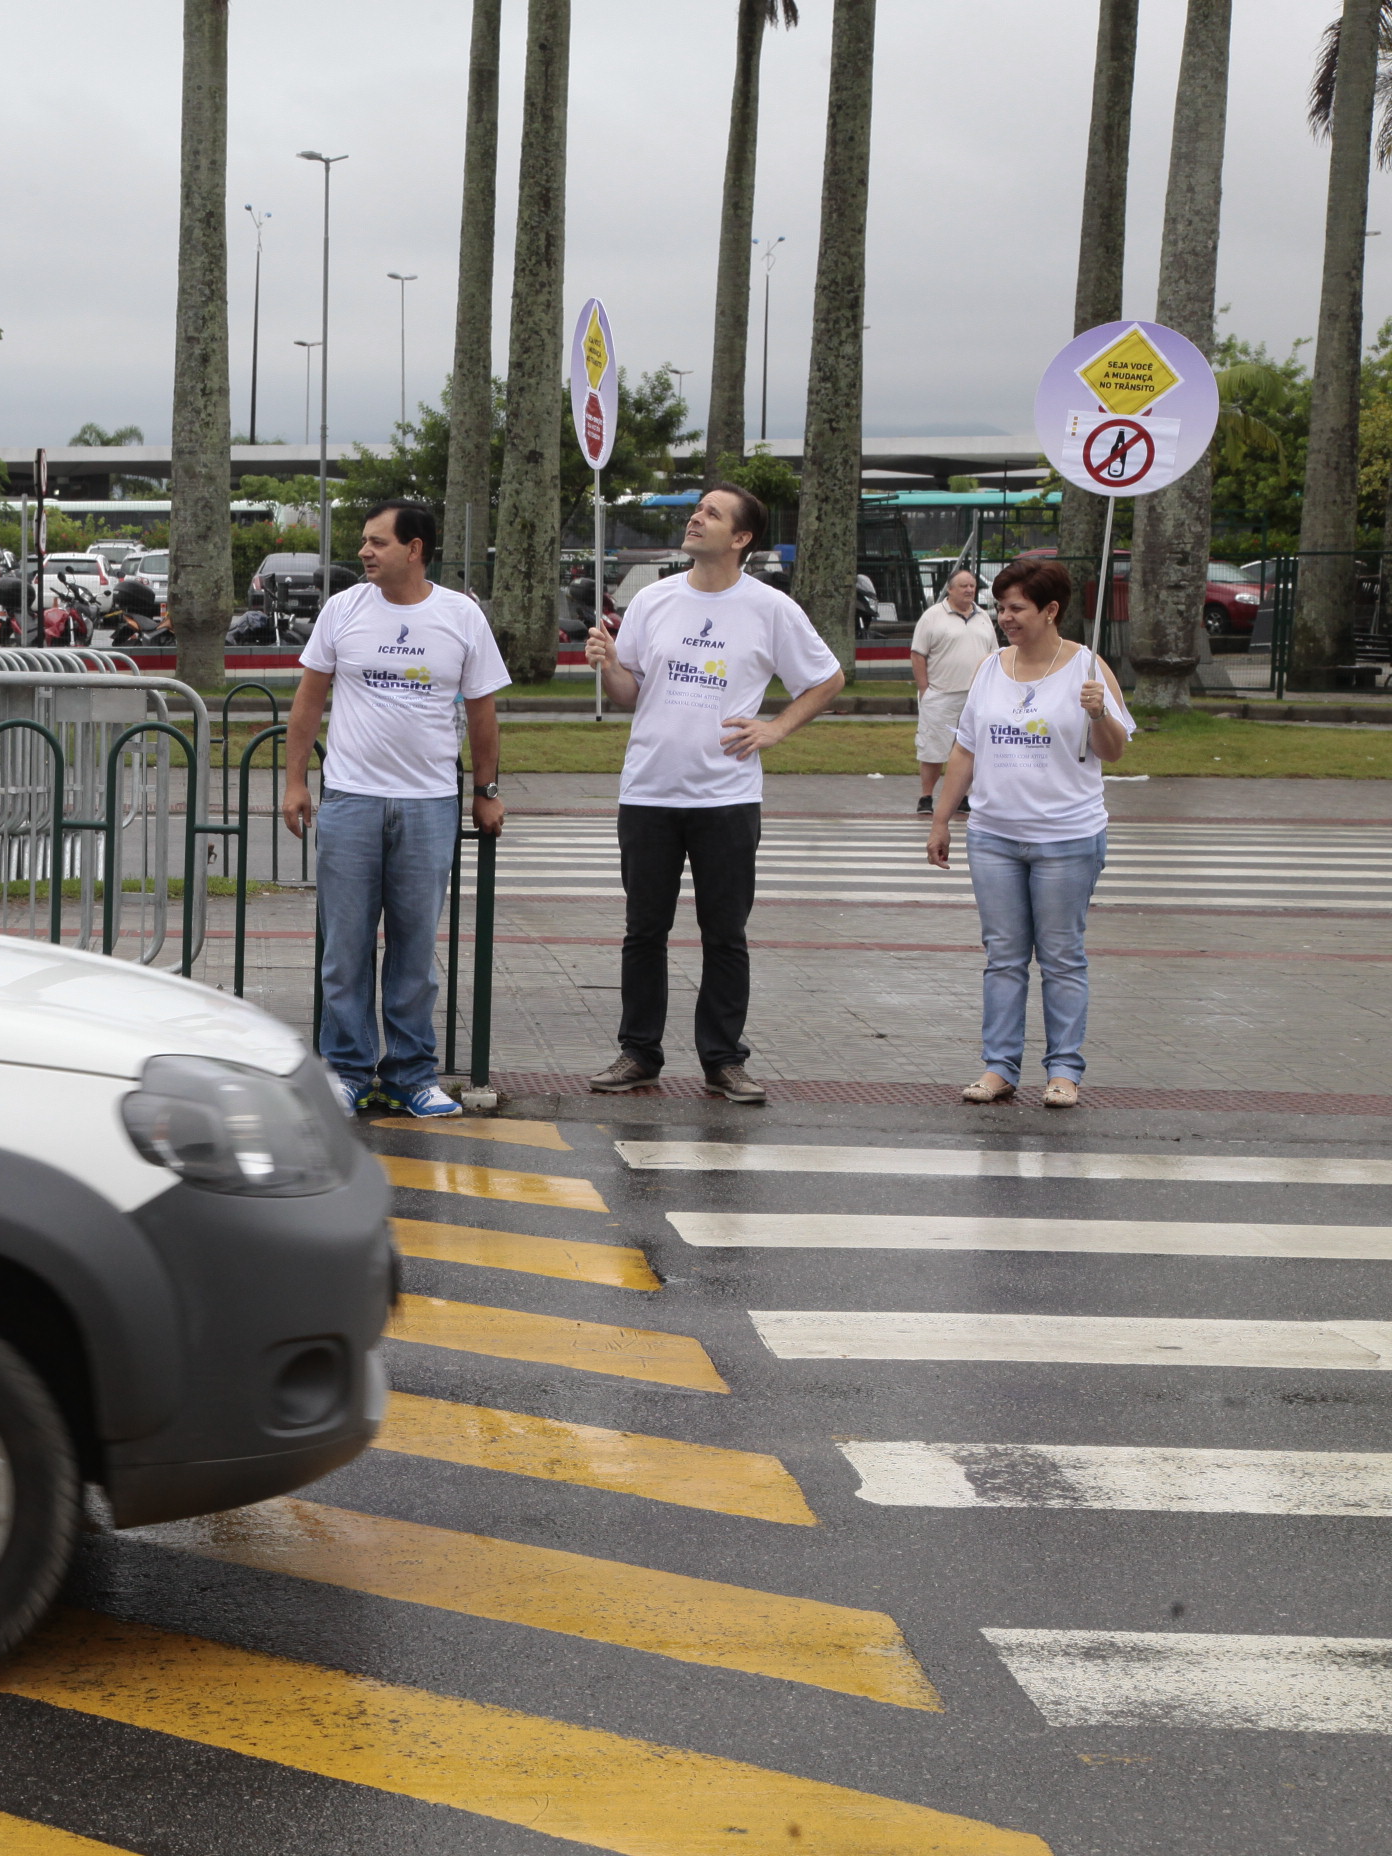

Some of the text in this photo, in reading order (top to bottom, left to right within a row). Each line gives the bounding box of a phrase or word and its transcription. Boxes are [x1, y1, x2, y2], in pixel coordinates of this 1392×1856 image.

[1107, 361, 1154, 371] SEJA VOCÊ
[1103, 371, 1154, 383] A MUDANÇA
[1099, 381, 1155, 393] NO TRÂNSITO
[682, 637, 726, 649] ICETRAN
[378, 645, 425, 655] ICETRAN
